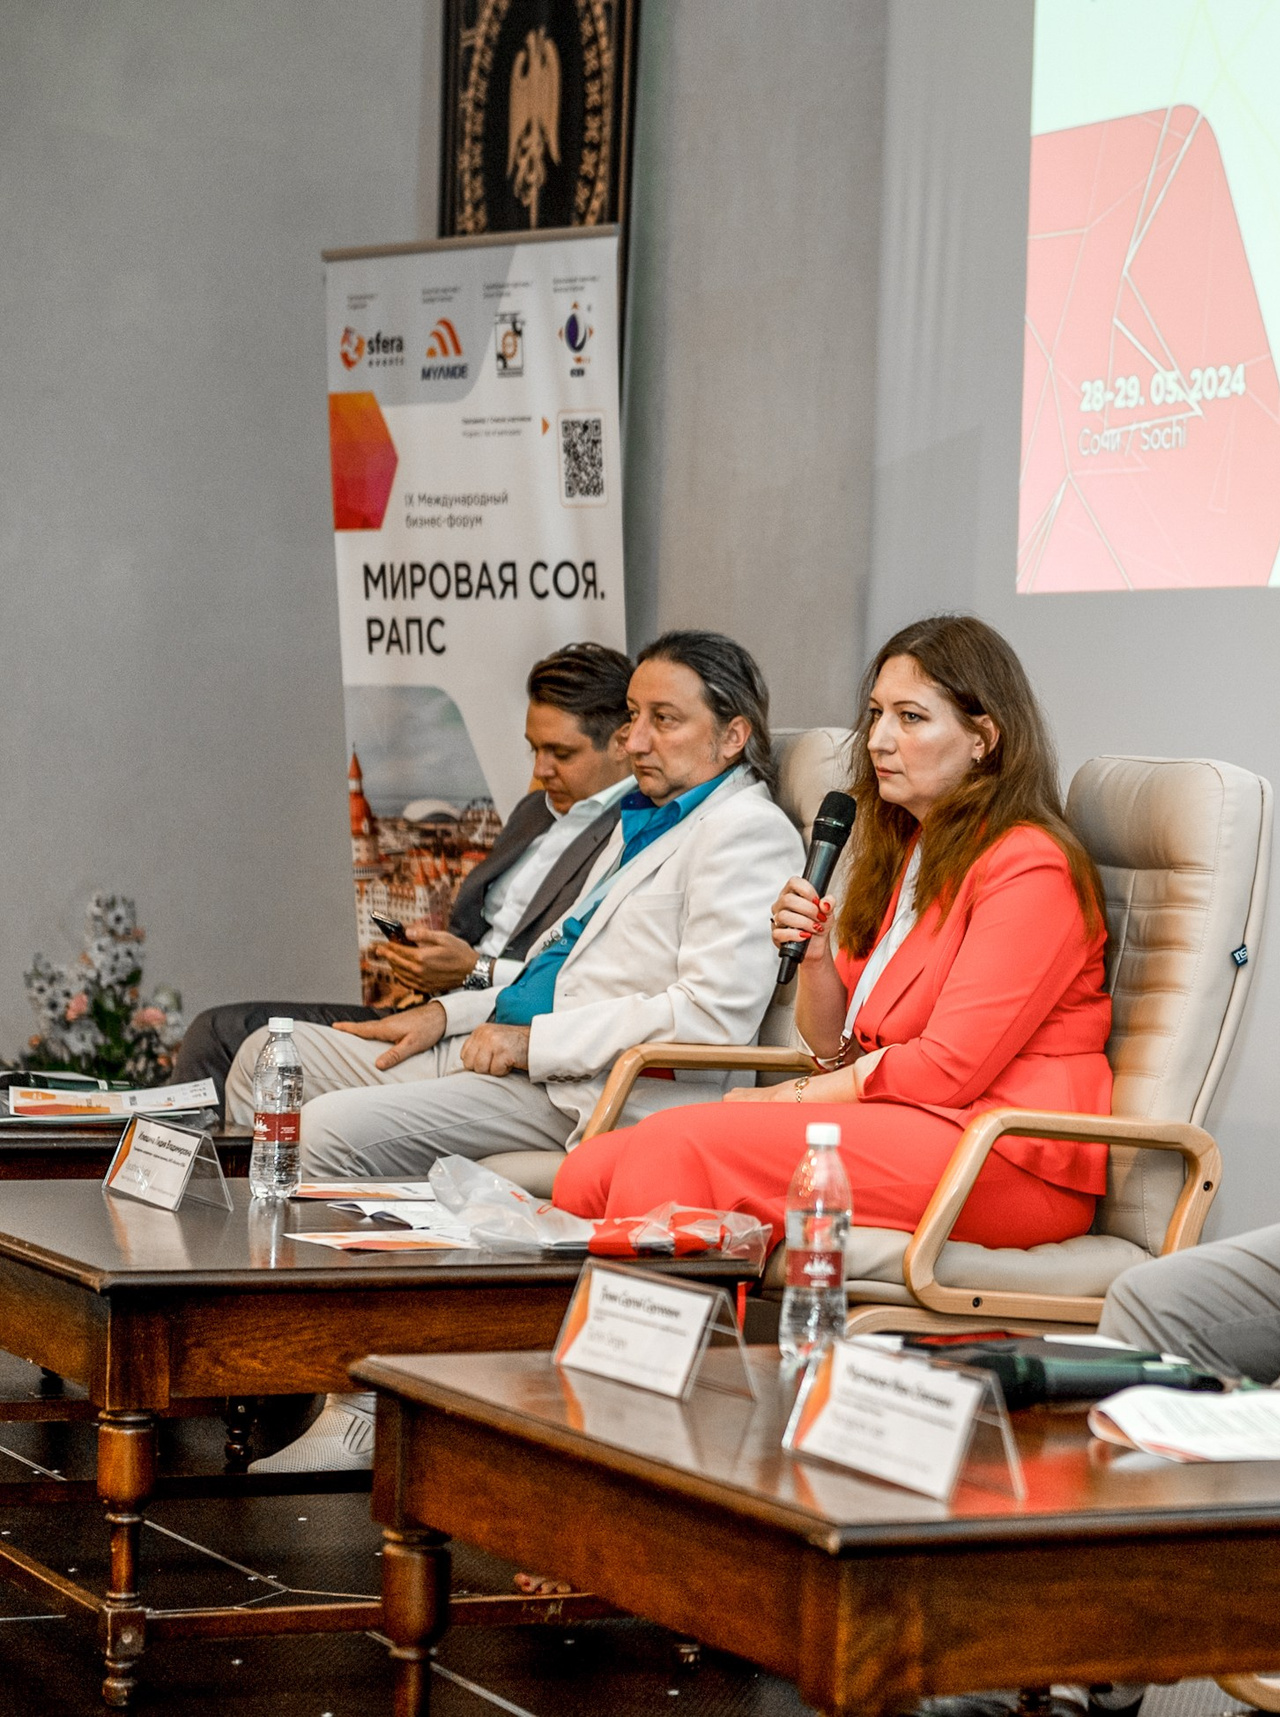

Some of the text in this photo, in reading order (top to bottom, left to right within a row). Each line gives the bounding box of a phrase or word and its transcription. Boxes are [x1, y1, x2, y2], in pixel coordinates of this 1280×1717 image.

[367, 330, 404, 355] sfera
[1140, 418, 1187, 451] Sochi
[418, 489, 509, 509] Международный
[405, 512, 483, 530] бизнес-форум
[363, 559, 606, 601] МИРОВАЯ СОЯ.
[366, 616, 447, 655] РАПС
